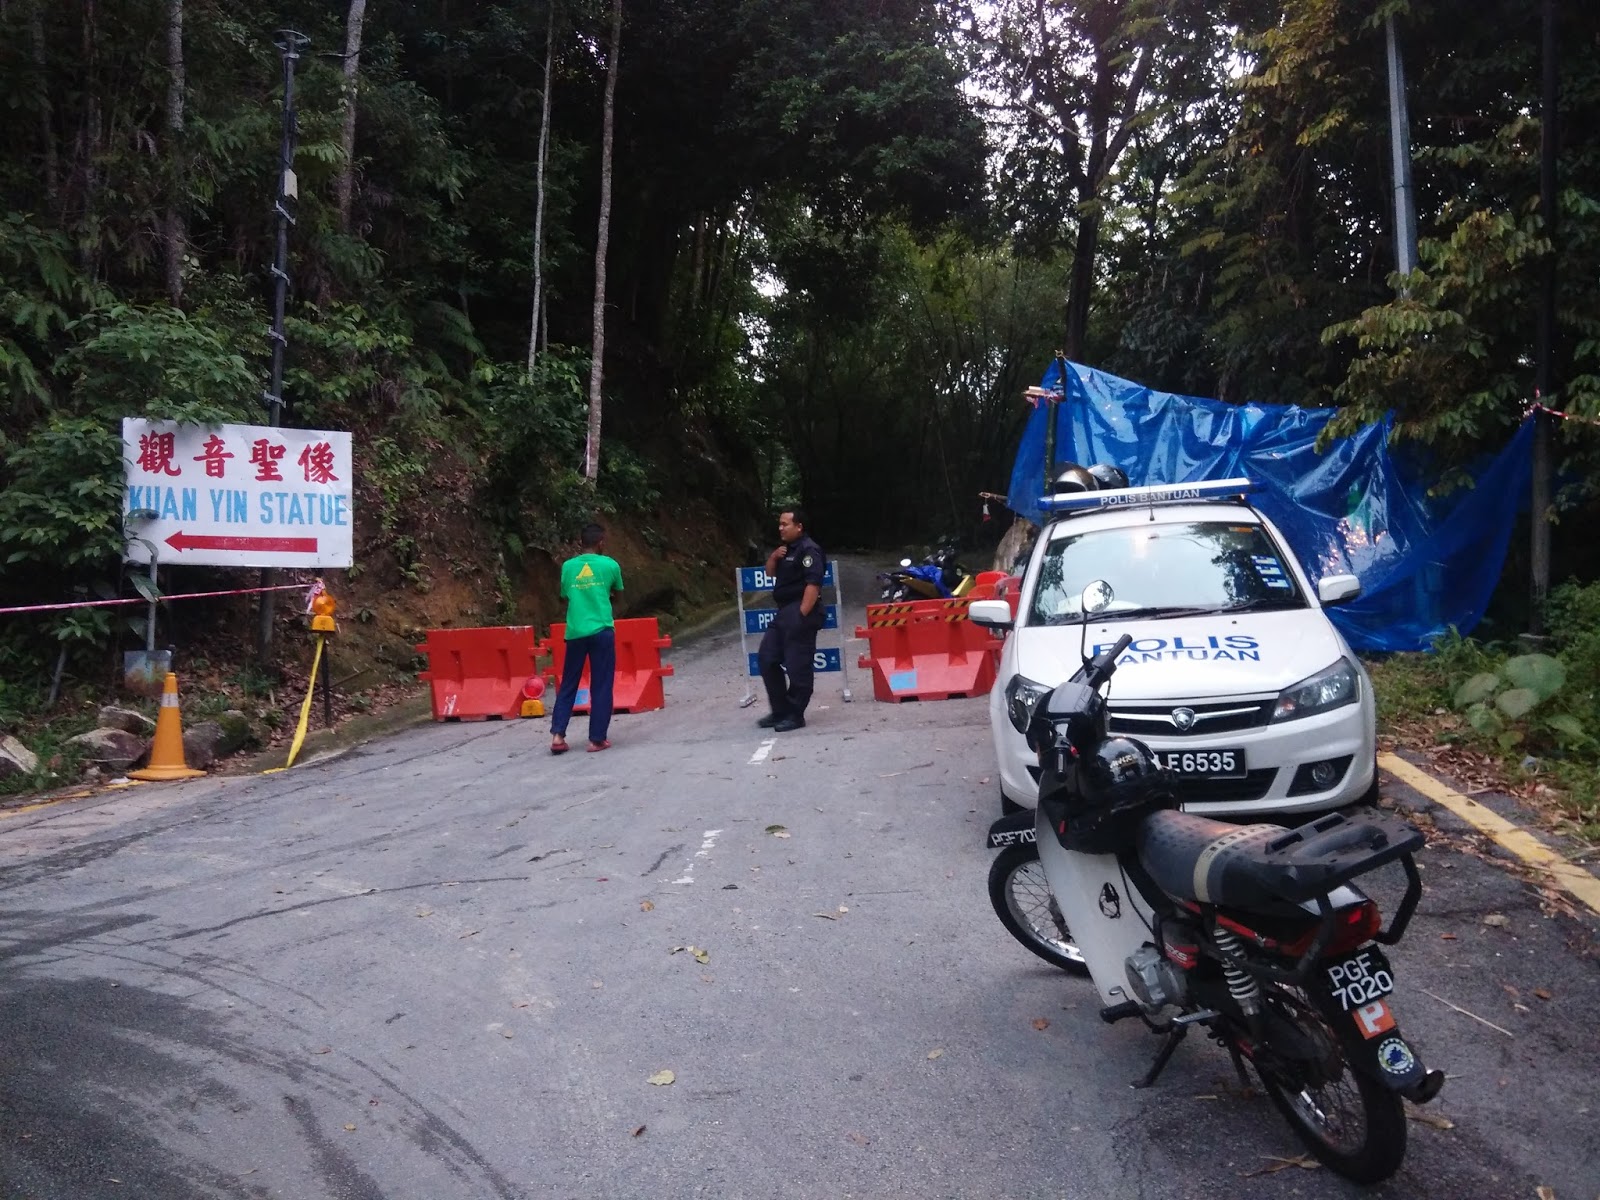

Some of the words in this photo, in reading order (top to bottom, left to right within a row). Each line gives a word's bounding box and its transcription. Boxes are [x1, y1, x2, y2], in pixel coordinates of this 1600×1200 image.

[136, 430, 339, 484] 觀音聖像
[129, 485, 197, 521] KUAN
[209, 488, 247, 523] YIN
[260, 491, 347, 526] STATUE
[1101, 494, 1136, 506] POLIS
[1140, 489, 1200, 502] BANTUAN
[1093, 636, 1259, 656] POLIS
[1117, 650, 1261, 666] ANTUAN
[1328, 952, 1372, 988] PGF
[1331, 970, 1394, 1011] 7020
[1357, 1001, 1385, 1033] P
